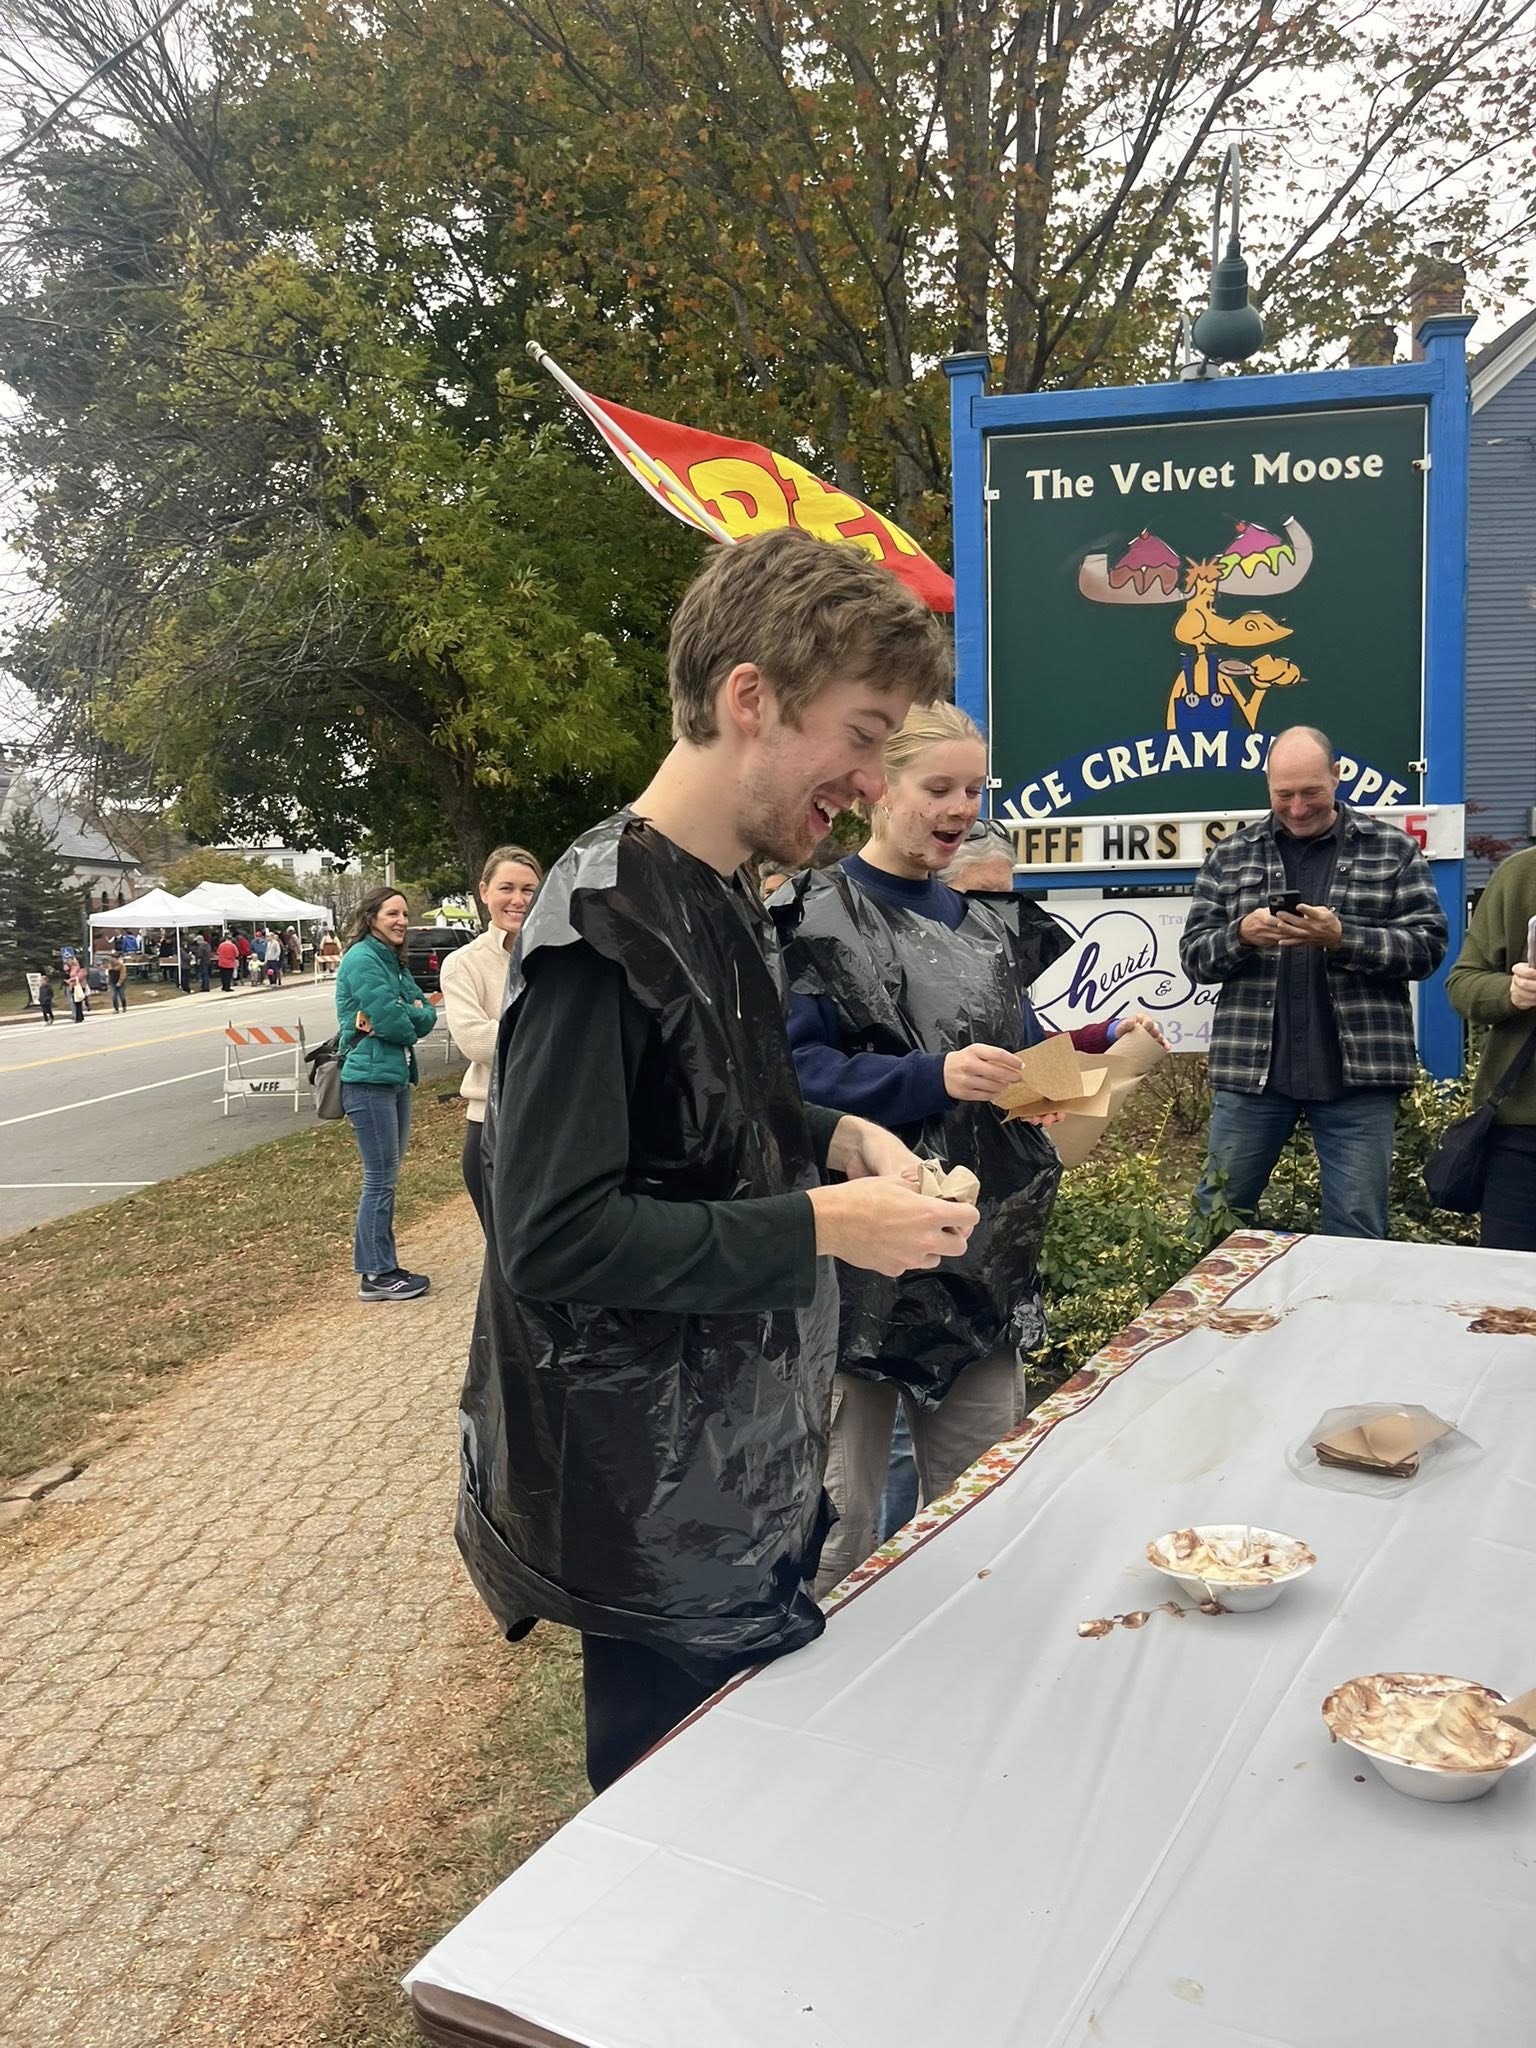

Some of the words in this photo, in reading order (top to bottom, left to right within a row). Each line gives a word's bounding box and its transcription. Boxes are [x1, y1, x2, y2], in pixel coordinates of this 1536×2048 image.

[1026, 468, 1094, 500] The
[1110, 461, 1236, 494] Velvet
[1251, 451, 1384, 486] Moose
[1003, 770, 1072, 819] ICE
[1081, 730, 1229, 790] CREAM
[1103, 823, 1178, 860] HRS
[1068, 941, 1151, 1014] heart
[1155, 980, 1172, 996] &
[249, 1081, 280, 1092] WFFF
